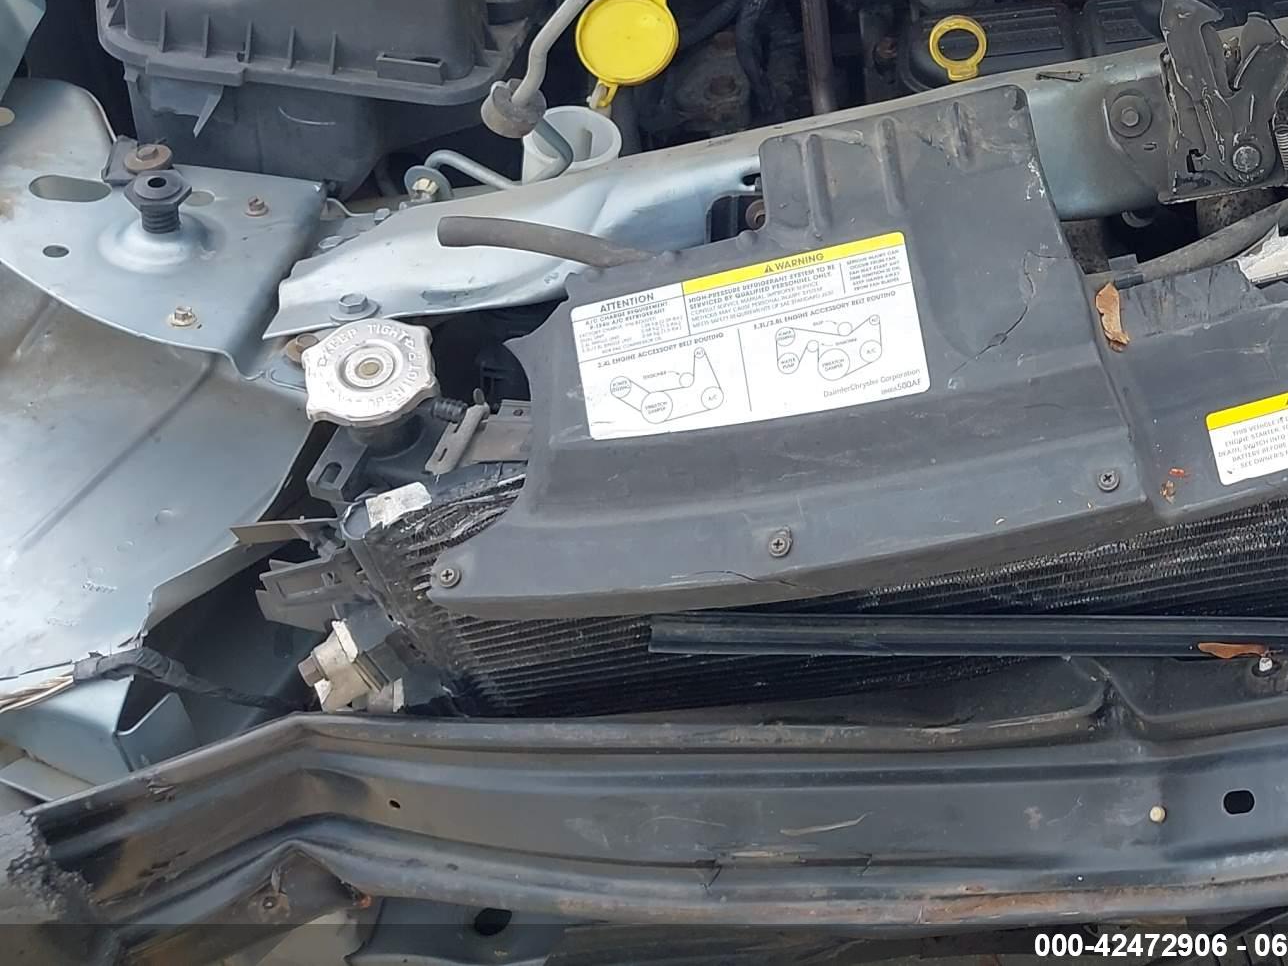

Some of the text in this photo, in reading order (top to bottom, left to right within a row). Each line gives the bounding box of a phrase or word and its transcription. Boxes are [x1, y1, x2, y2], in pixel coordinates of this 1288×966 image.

[774, 252, 824, 271] WARNING
[599, 292, 655, 312] ATTENTION
[611, 354, 635, 364] ENGINE
[637, 344, 677, 357] ACCESSORY
[678, 339, 692, 347] BELT
[693, 332, 724, 344] ROUTING
[822, 368, 921, 397] DaimlerChrysler Corporation
